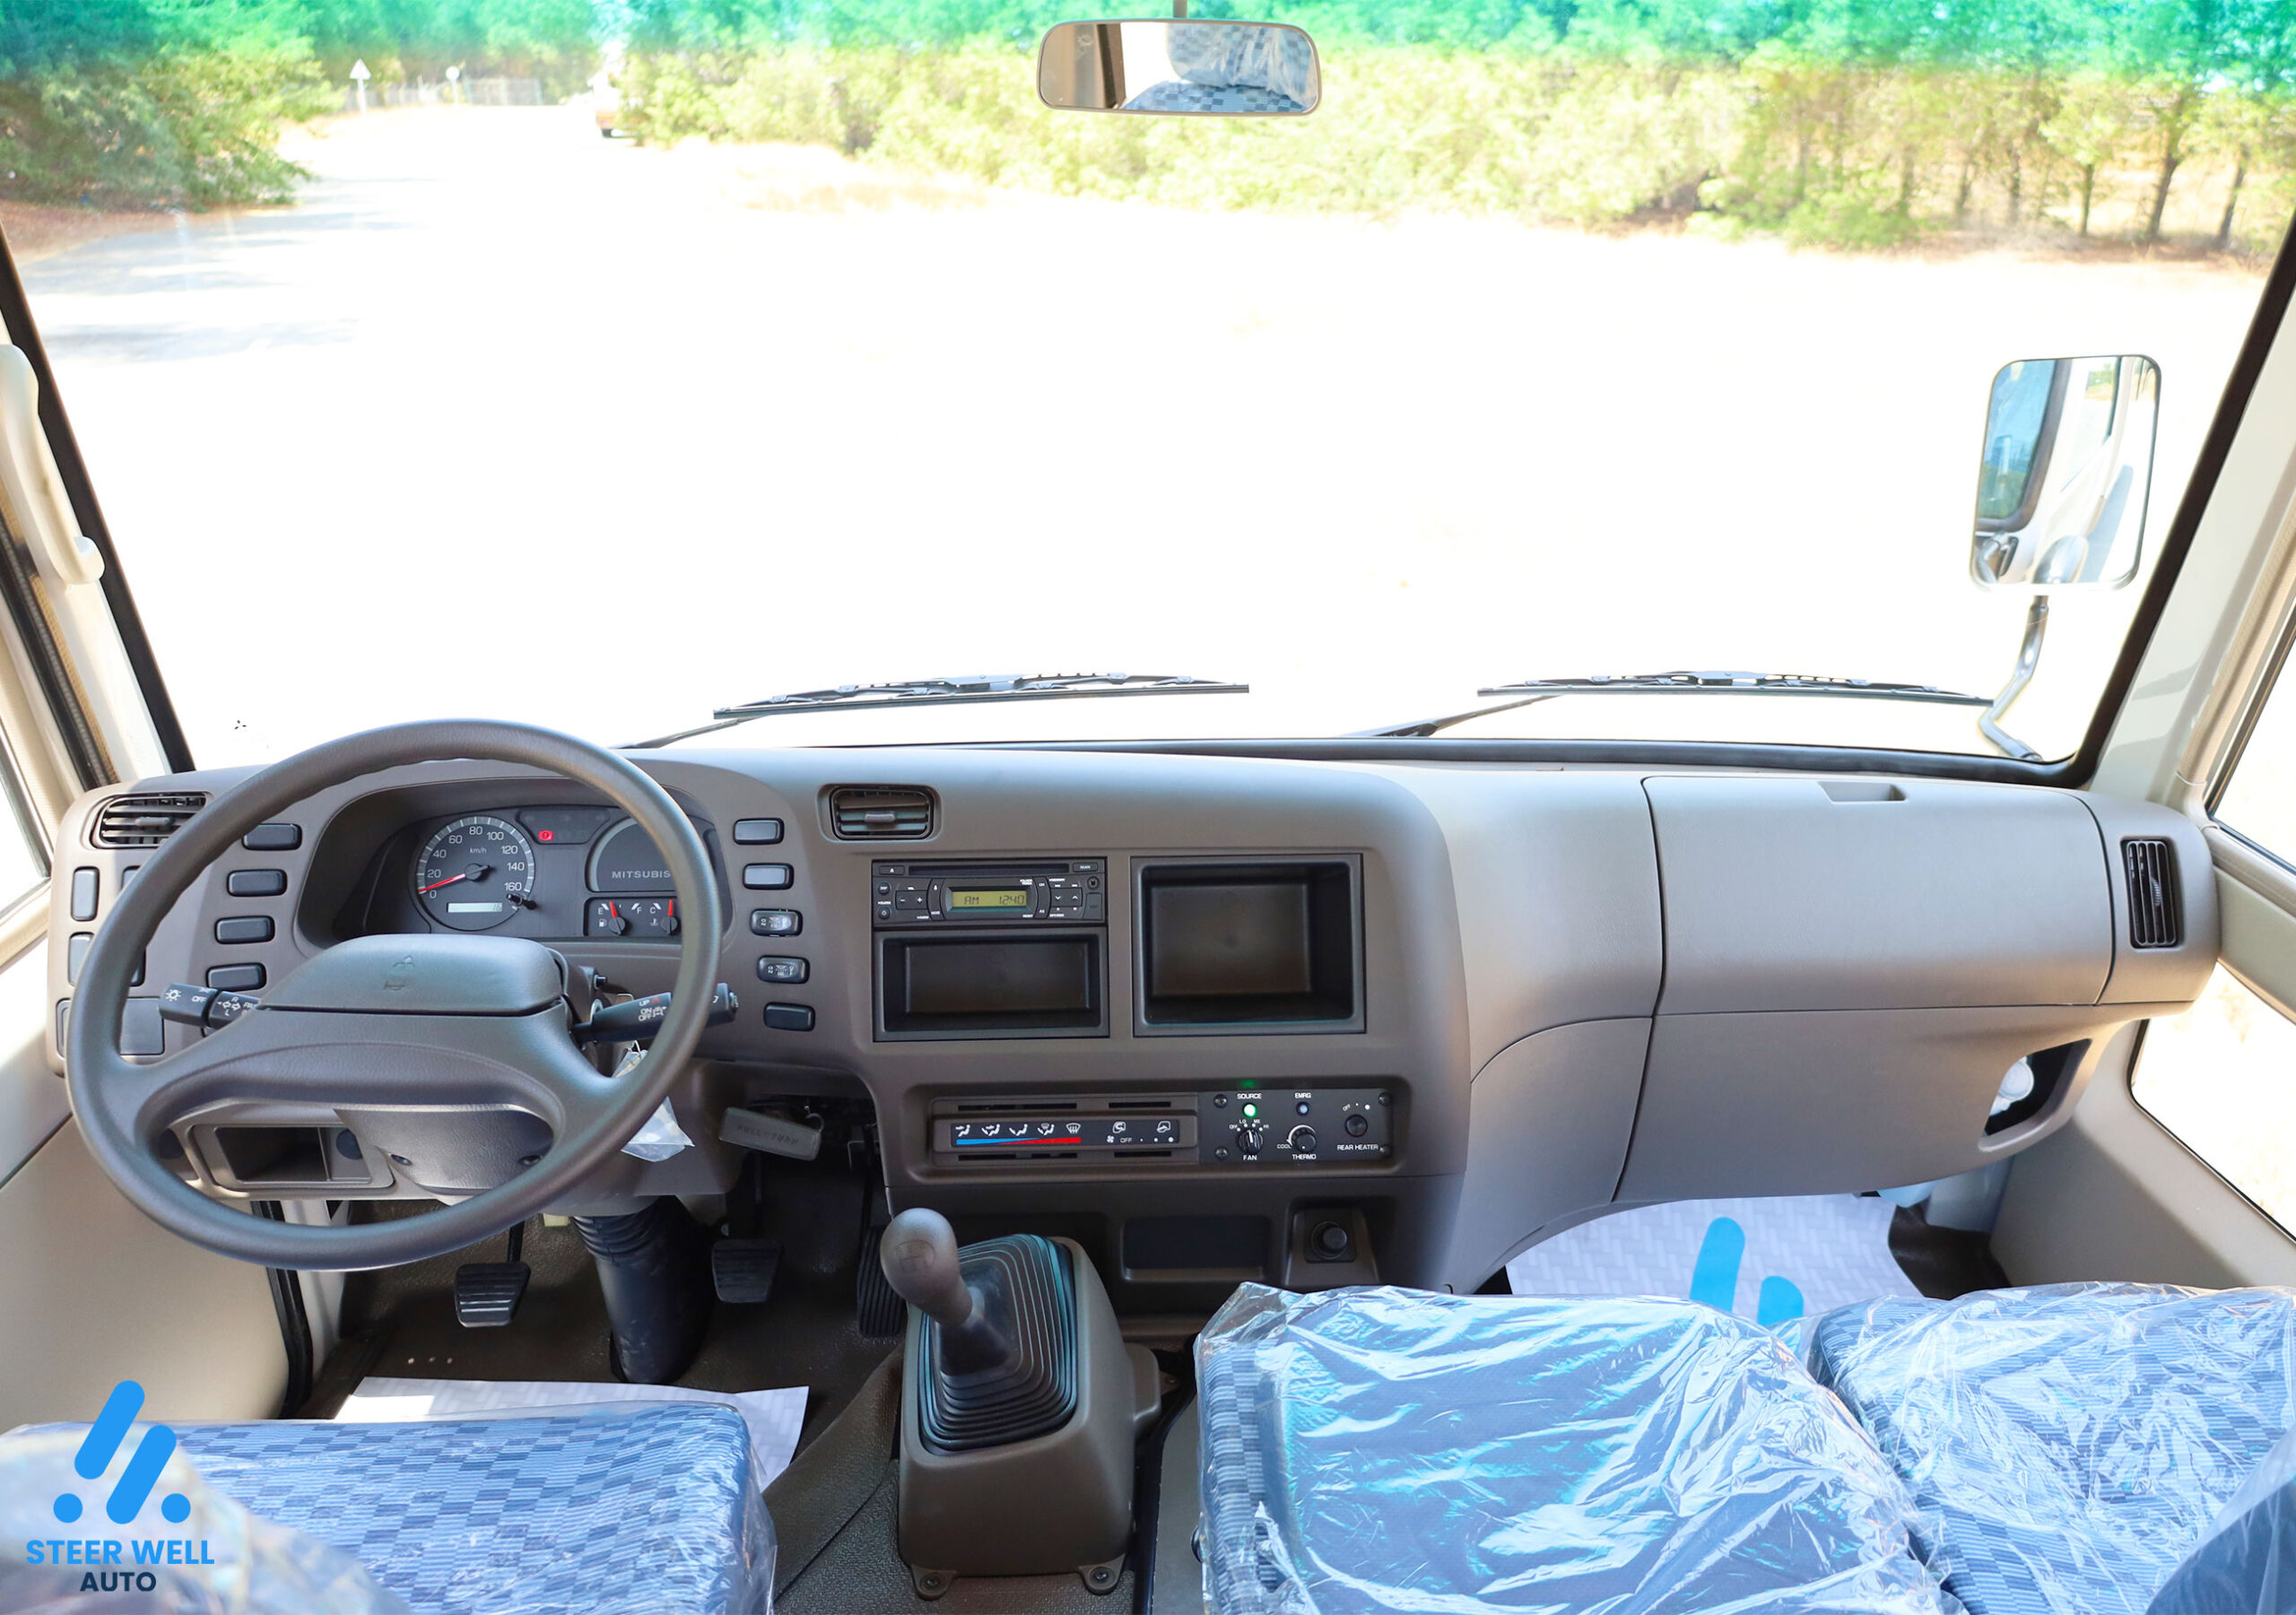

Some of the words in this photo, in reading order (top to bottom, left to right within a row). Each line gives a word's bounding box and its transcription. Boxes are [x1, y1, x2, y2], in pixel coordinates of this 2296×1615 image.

[469, 826, 483, 835] 80
[448, 835, 463, 844] 60
[486, 831, 504, 840] 100
[432, 849, 447, 858] 40
[500, 845, 517, 855] 120
[507, 862, 525, 872] 140
[427, 869, 441, 878] 20
[612, 870, 671, 879] MITSUBIS
[504, 881, 522, 891] 160
[430, 890, 437, 899] 0
[964, 896, 979, 905] AM
[1342, 1104, 1351, 1112] OFF
